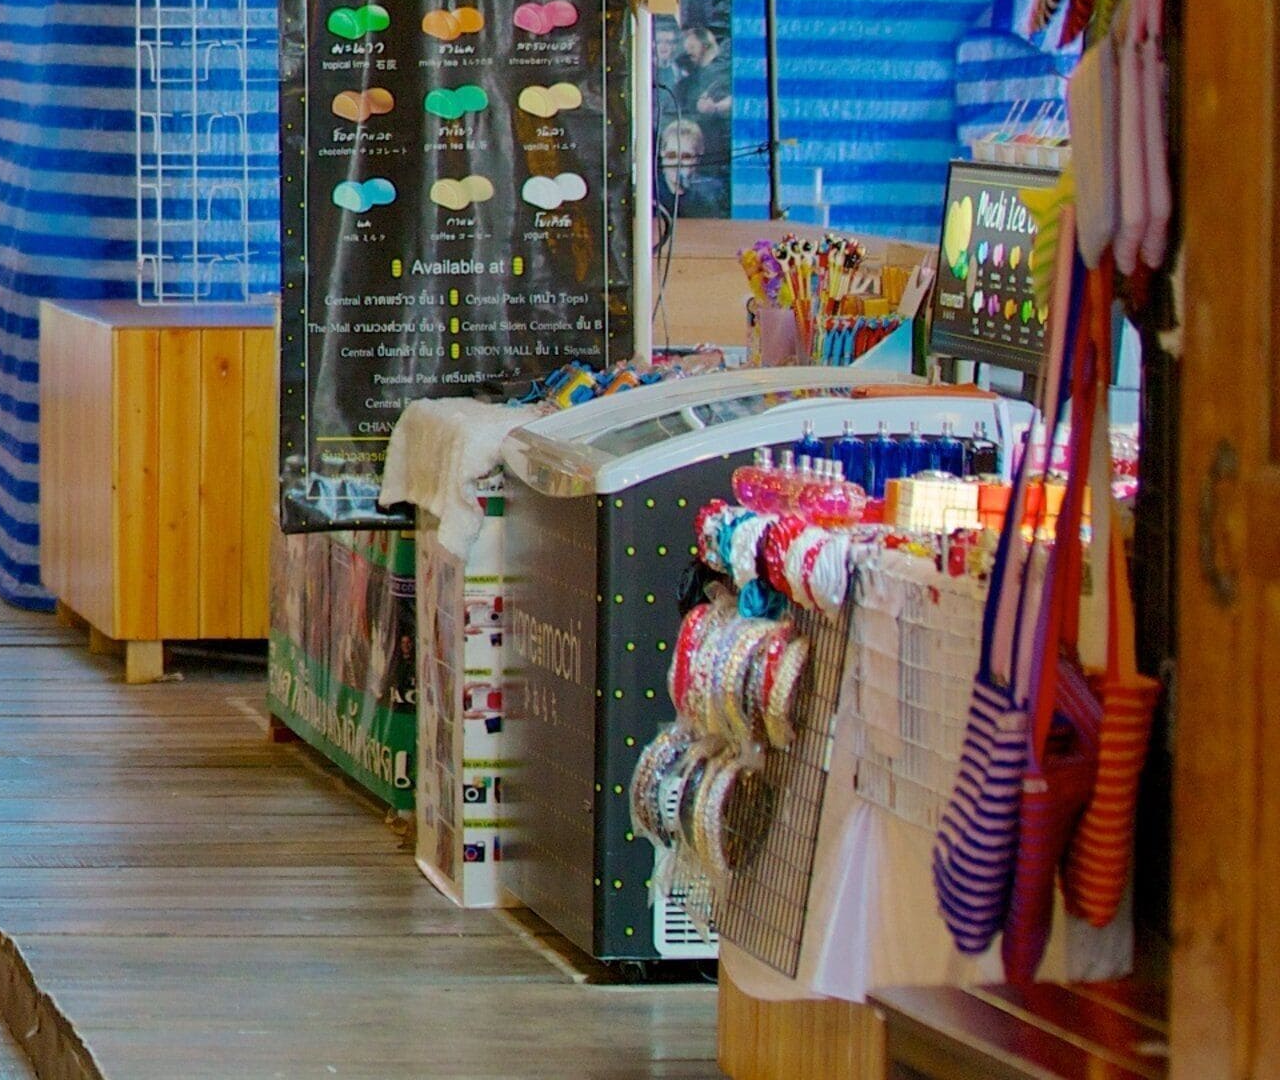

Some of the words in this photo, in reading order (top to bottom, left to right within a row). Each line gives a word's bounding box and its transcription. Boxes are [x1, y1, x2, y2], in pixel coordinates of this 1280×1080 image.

[322, 60, 352, 71] tropical
[318, 142, 357, 156] chocolate
[411, 258, 485, 276] Available
[489, 260, 505, 274] at
[324, 294, 361, 306] Central
[465, 293, 500, 307] Crystal
[502, 292, 526, 305] Park
[560, 292, 589, 306] Tops)
[308, 323, 327, 333] The
[328, 322, 350, 333] Mall
[461, 322, 497, 333] Central
[499, 321, 528, 332] Silom
[529, 320, 574, 333] Complex
[340, 347, 375, 358] Central
[465, 346, 502, 356] UNION
[503, 345, 533, 356] MALL
[563, 344, 601, 357] Skywalk
[374, 373, 412, 385] Paradise
[415, 373, 439, 384] Park
[365, 398, 402, 409] Central
[542, 616, 583, 686] mochi
